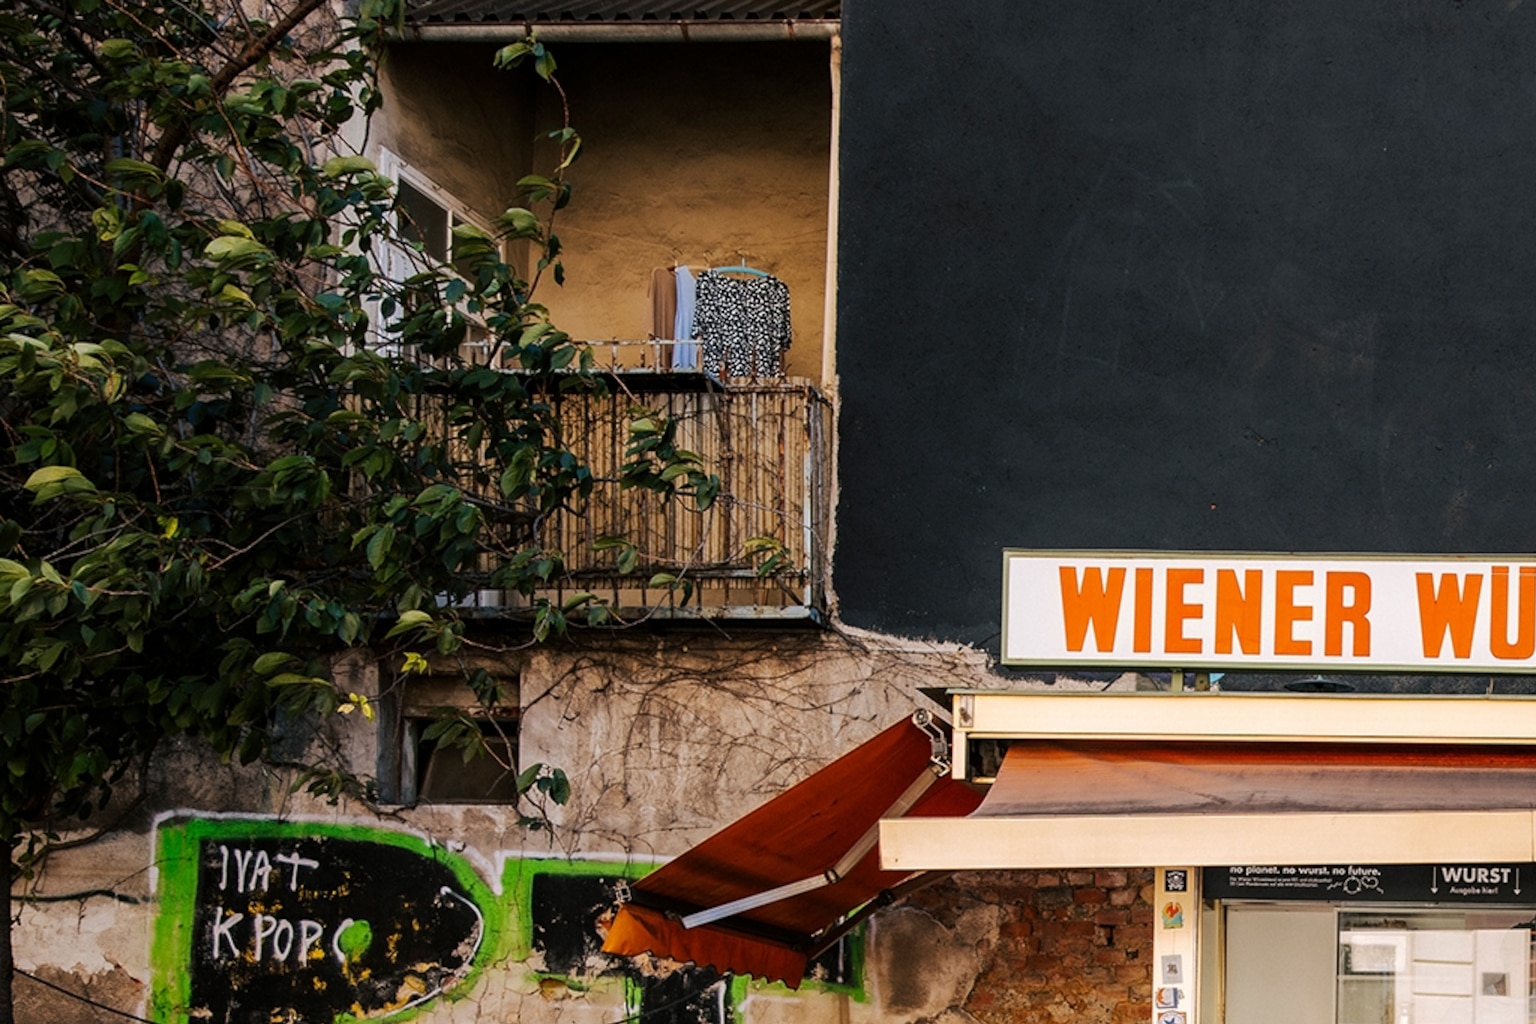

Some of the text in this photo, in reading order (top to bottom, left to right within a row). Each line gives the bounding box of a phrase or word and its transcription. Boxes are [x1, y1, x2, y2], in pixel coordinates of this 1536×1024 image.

[1059, 566, 1371, 657] WIENER
[1229, 867, 1243, 875] no
[1282, 867, 1296, 875] no
[1332, 867, 1346, 876] no
[1347, 865, 1381, 876] future.
[1442, 867, 1511, 884] WURST
